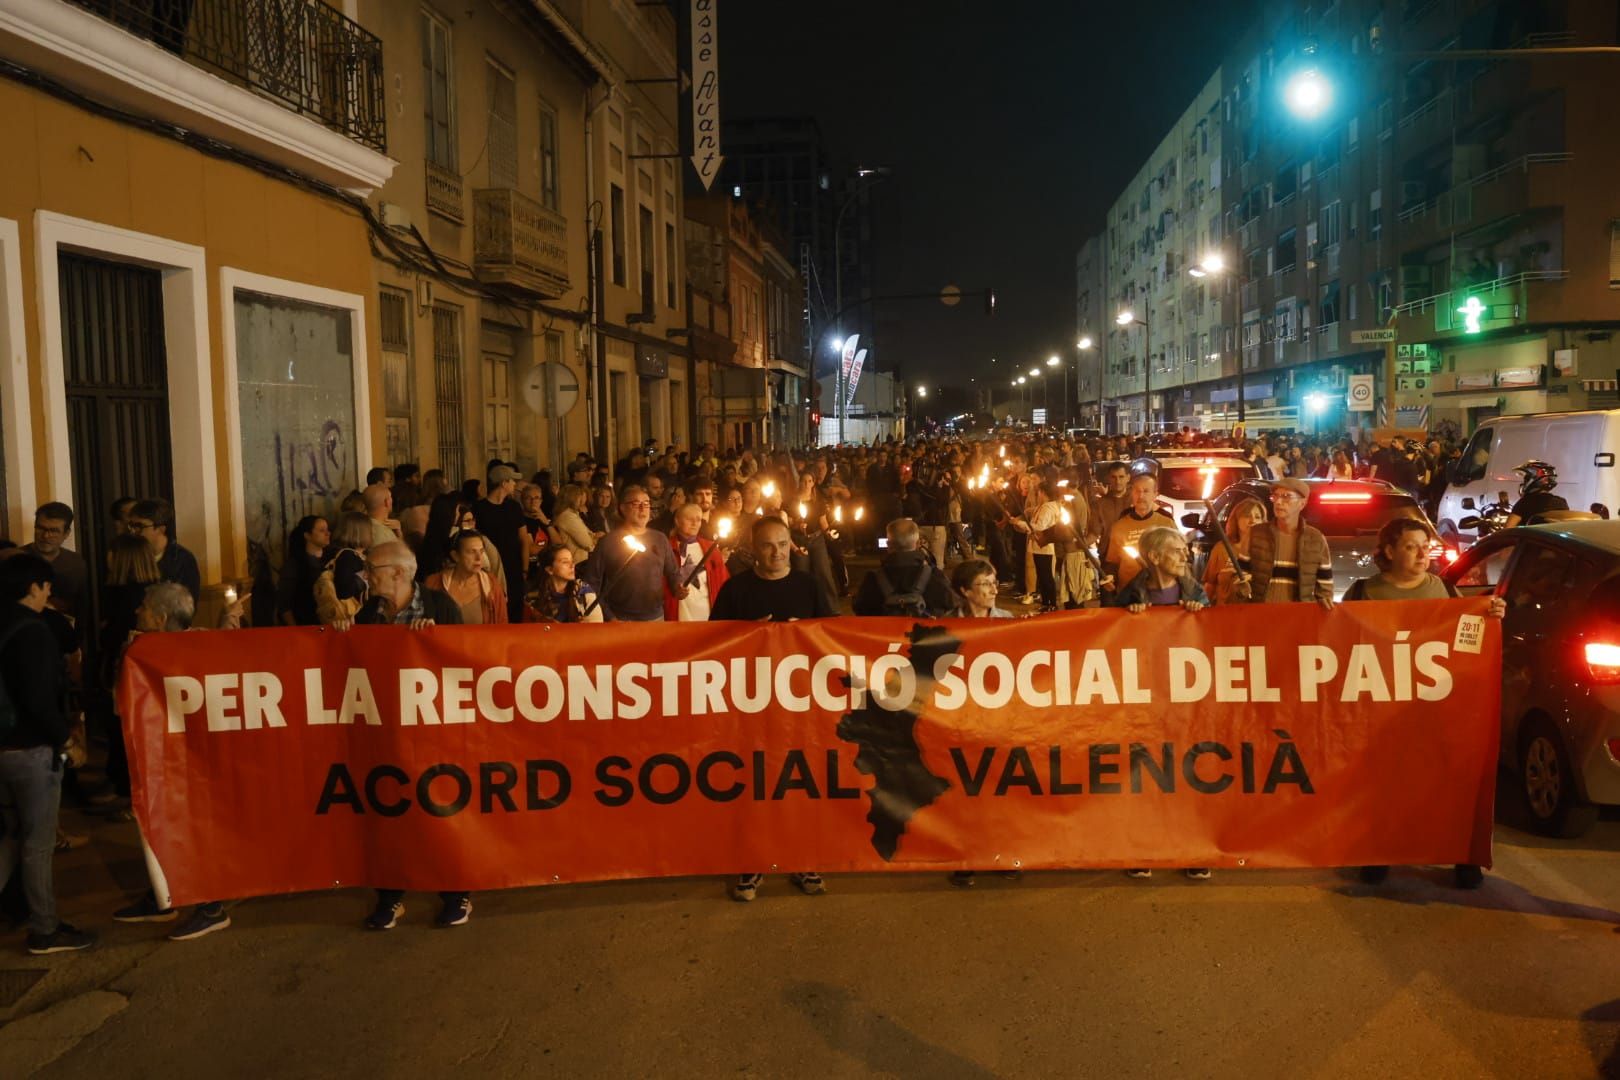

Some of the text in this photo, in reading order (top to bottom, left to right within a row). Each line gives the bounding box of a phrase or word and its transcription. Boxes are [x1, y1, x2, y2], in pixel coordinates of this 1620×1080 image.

[696, 70, 717, 177] Avant
[163, 630, 1454, 734] PER LA RECONSTRUCCIÓ SOCIAL DEL PAÍS
[315, 728, 1316, 818] ACORD SOCIAL VALENCIÀ
